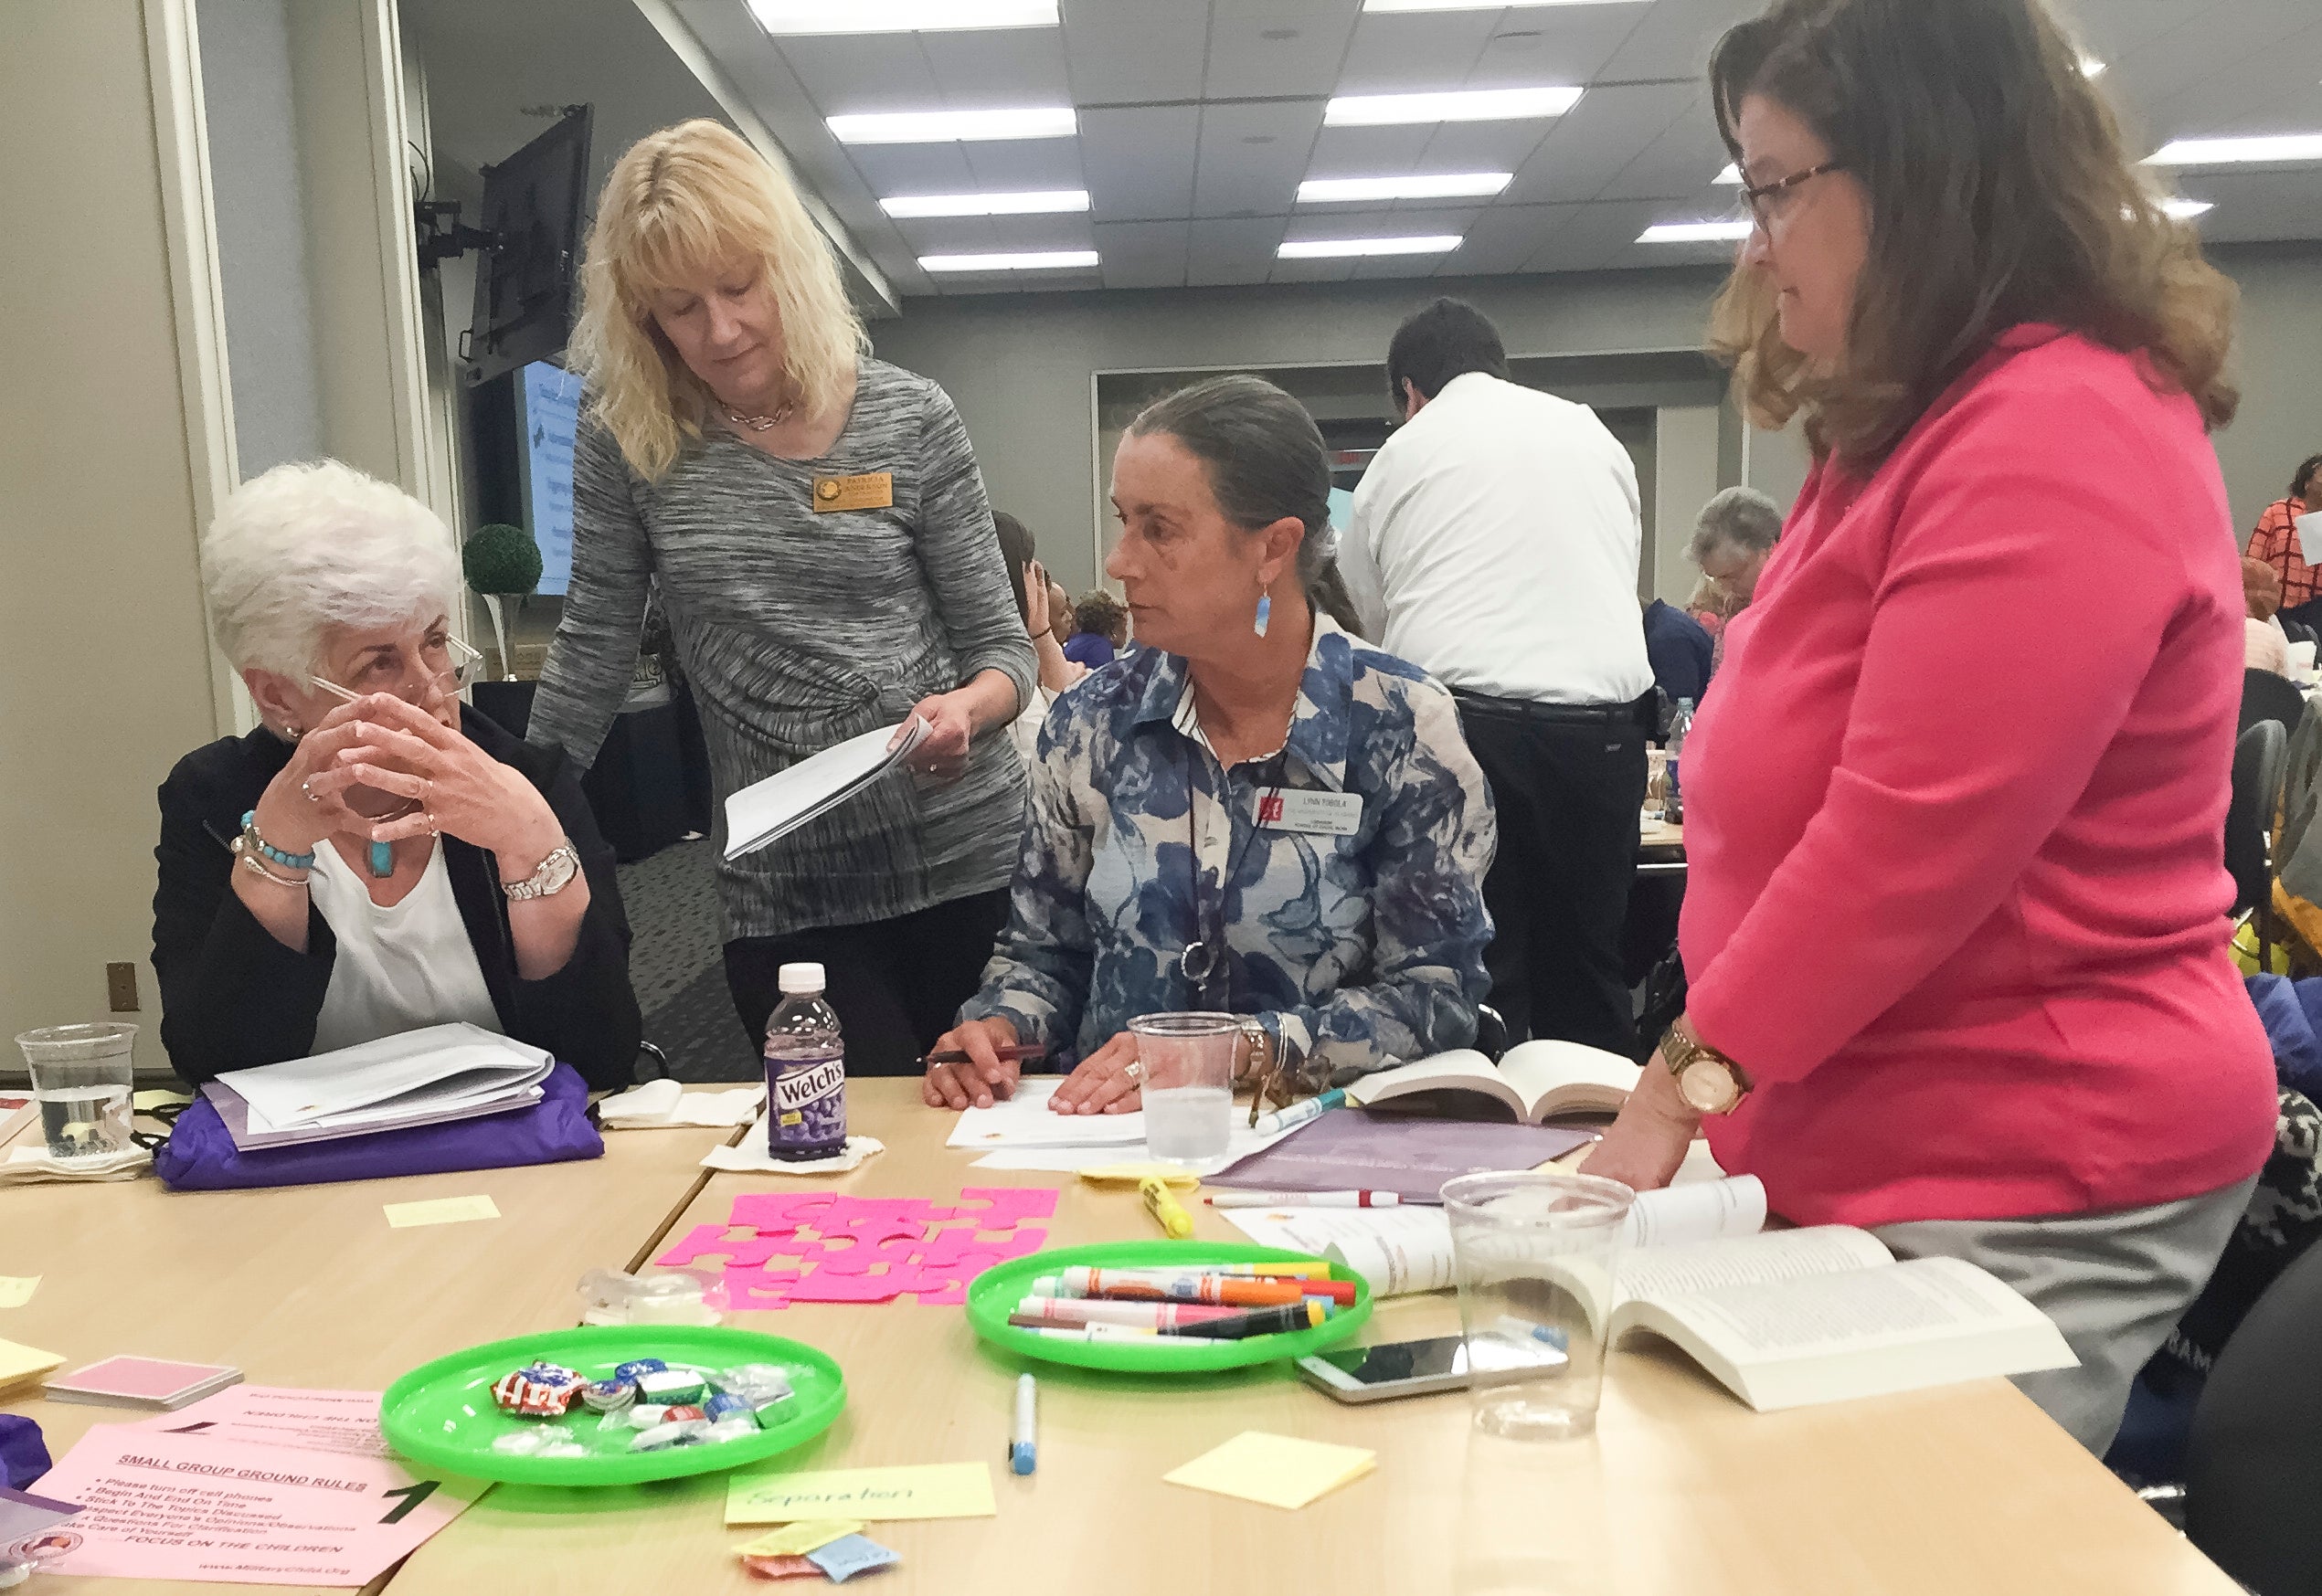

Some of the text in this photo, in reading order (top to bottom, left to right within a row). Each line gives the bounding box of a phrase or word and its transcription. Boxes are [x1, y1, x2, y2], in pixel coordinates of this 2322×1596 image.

[780, 1062, 842, 1103] Welch's
[118, 1453, 367, 1492] SMALL GROUP GROUND RULES
[95, 1486, 133, 1498] Begin
[134, 1492, 163, 1501] And
[164, 1495, 191, 1504] End
[105, 1478, 272, 1503] Please turn off cell phones
[746, 1486, 914, 1508] Separation
[85, 1495, 116, 1506] Stick
[141, 1501, 164, 1510] The
[377, 1480, 440, 1525] 1
[124, 1535, 344, 1553] FOCUS ON THE CHILDREN
